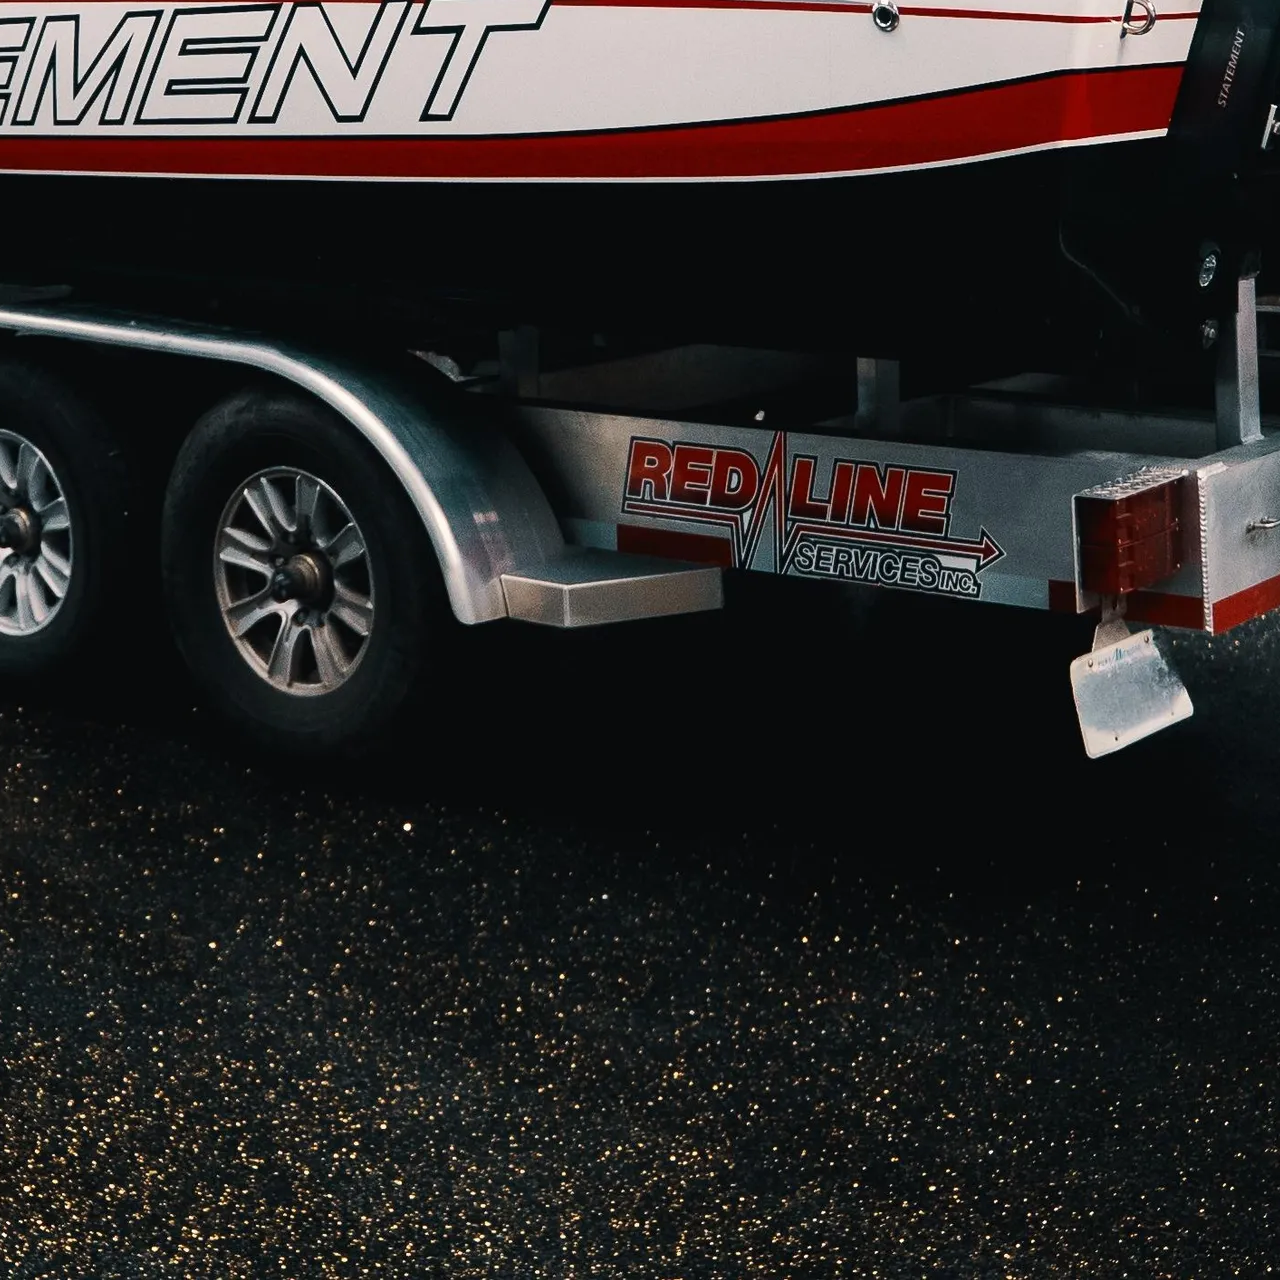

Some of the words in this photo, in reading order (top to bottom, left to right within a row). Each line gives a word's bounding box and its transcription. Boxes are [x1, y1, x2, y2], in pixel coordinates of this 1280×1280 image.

[1217, 28, 1246, 108] STATEMENT
[627, 437, 762, 510] RED
[788, 454, 958, 536] LINE
[794, 539, 941, 589] SERVICES
[939, 569, 981, 597] INC.
